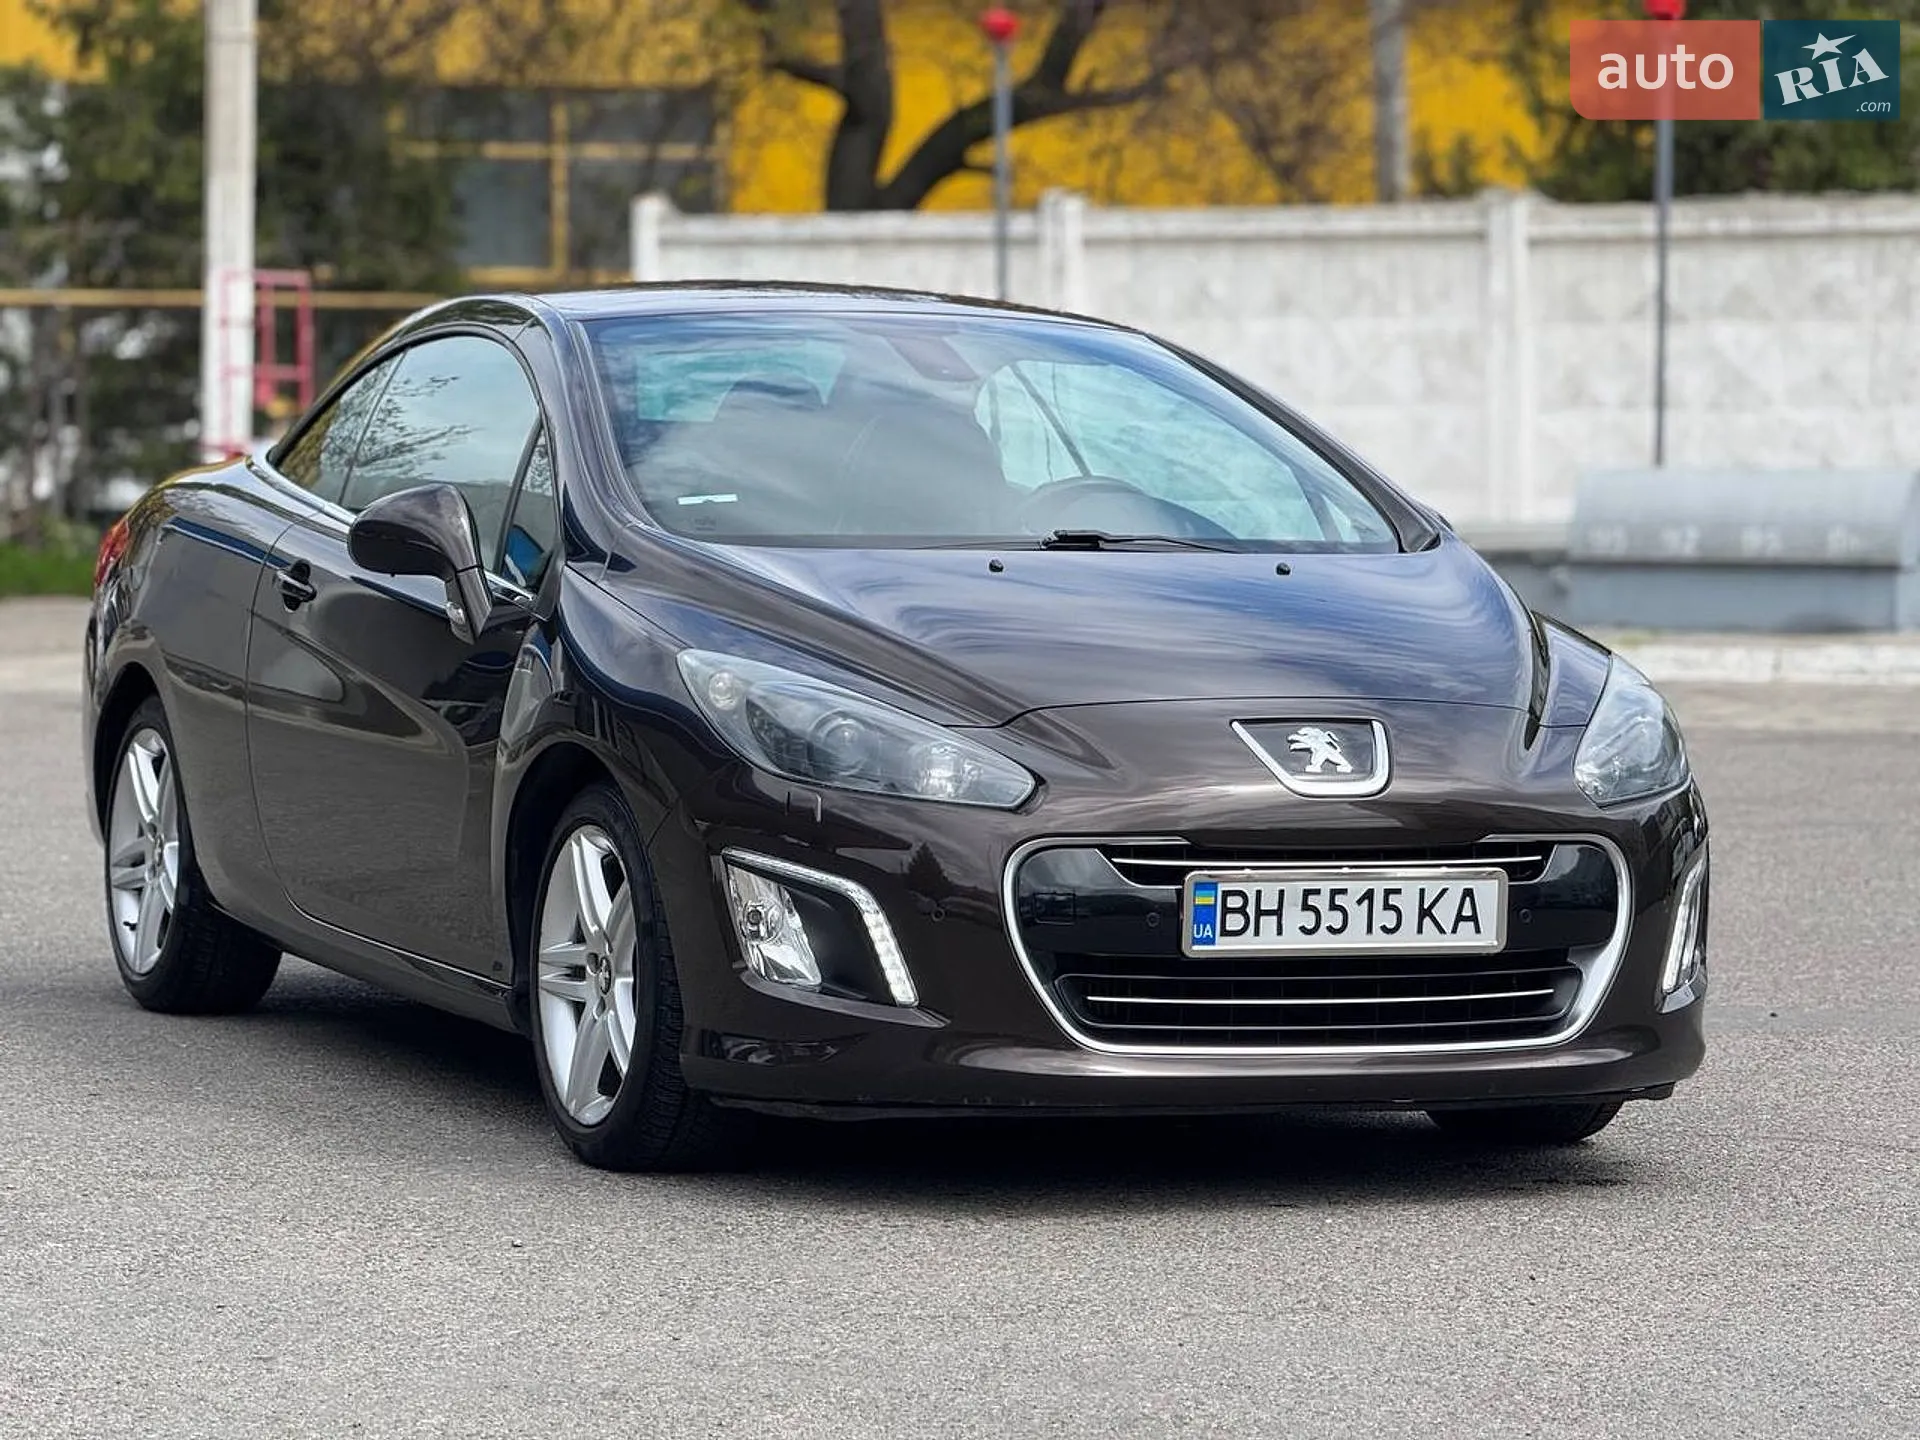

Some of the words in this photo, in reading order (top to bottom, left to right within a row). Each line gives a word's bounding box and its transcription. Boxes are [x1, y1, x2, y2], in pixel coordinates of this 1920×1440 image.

[1219, 888, 1285, 937] BH
[1298, 887, 1402, 936] 5515
[1416, 887, 1482, 935] KA
[1194, 924, 1214, 939] UA
